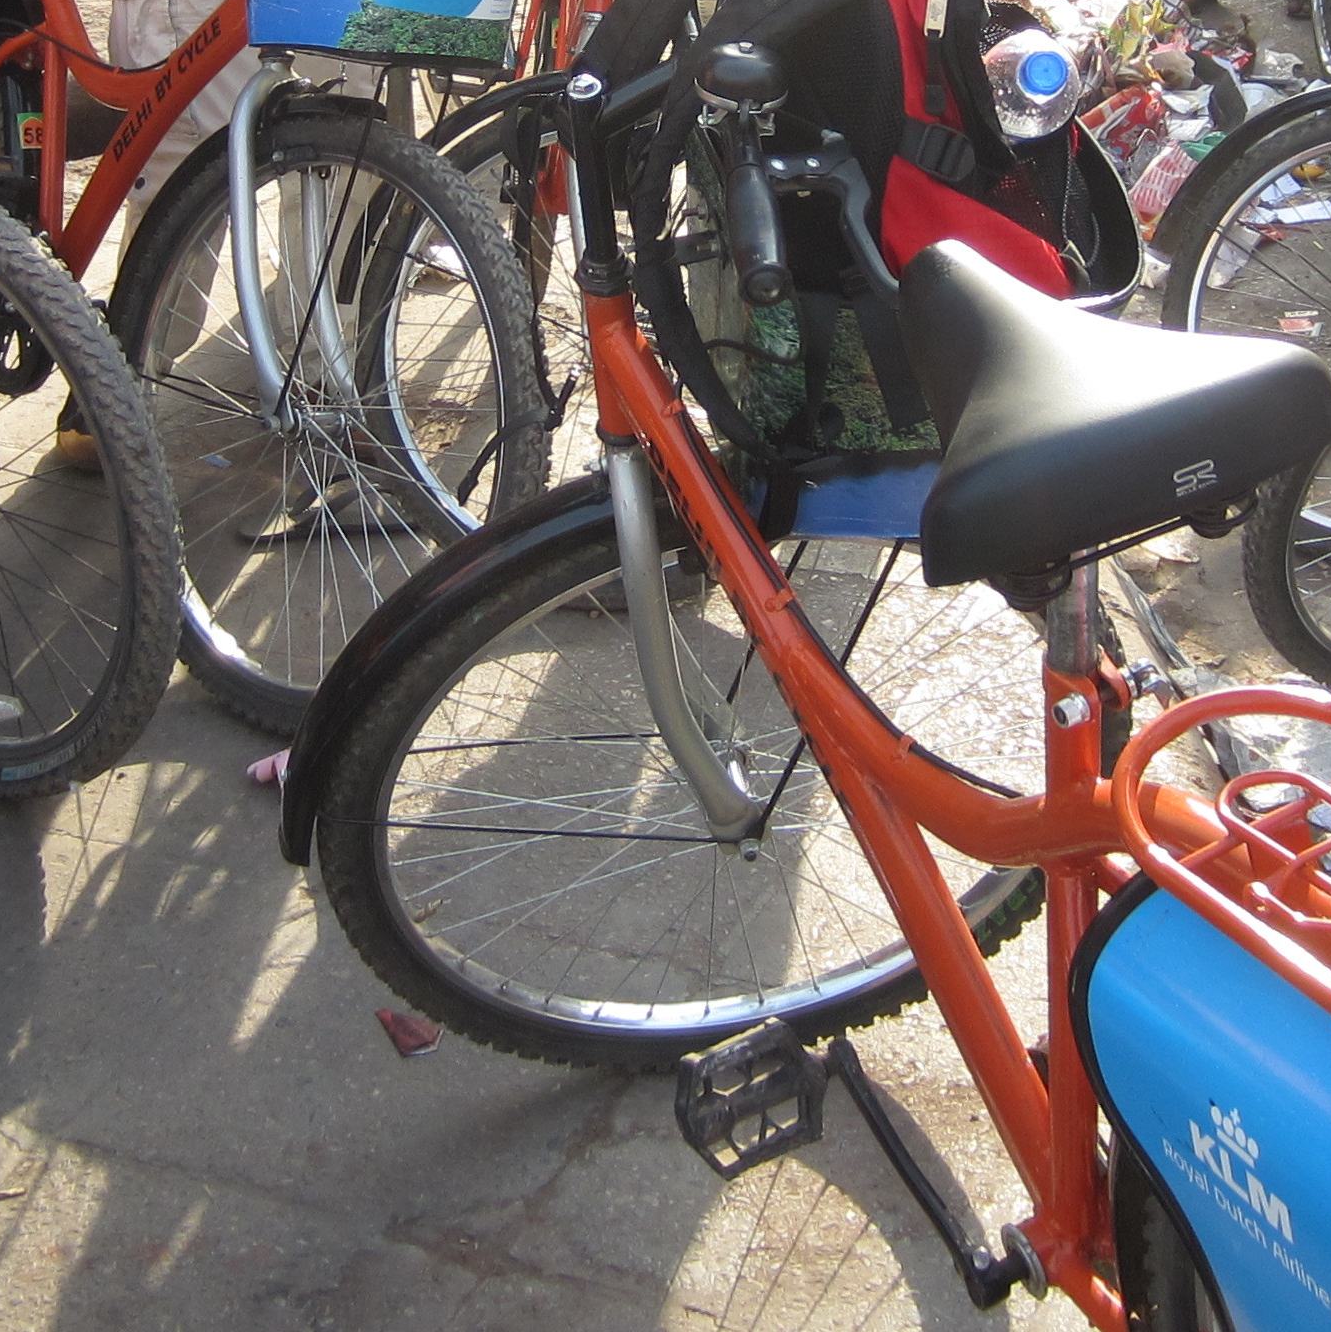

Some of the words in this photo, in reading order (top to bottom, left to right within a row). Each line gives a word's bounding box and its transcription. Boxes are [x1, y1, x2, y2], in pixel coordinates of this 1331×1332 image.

[113, 96, 153, 163] DELHI
[155, 69, 173, 102] BY
[177, 18, 222, 73] CYCLE
[1161, 1136, 1211, 1197] Royal
[1213, 1183, 1268, 1250] Dutch
[1188, 1118, 1295, 1244] KLM
